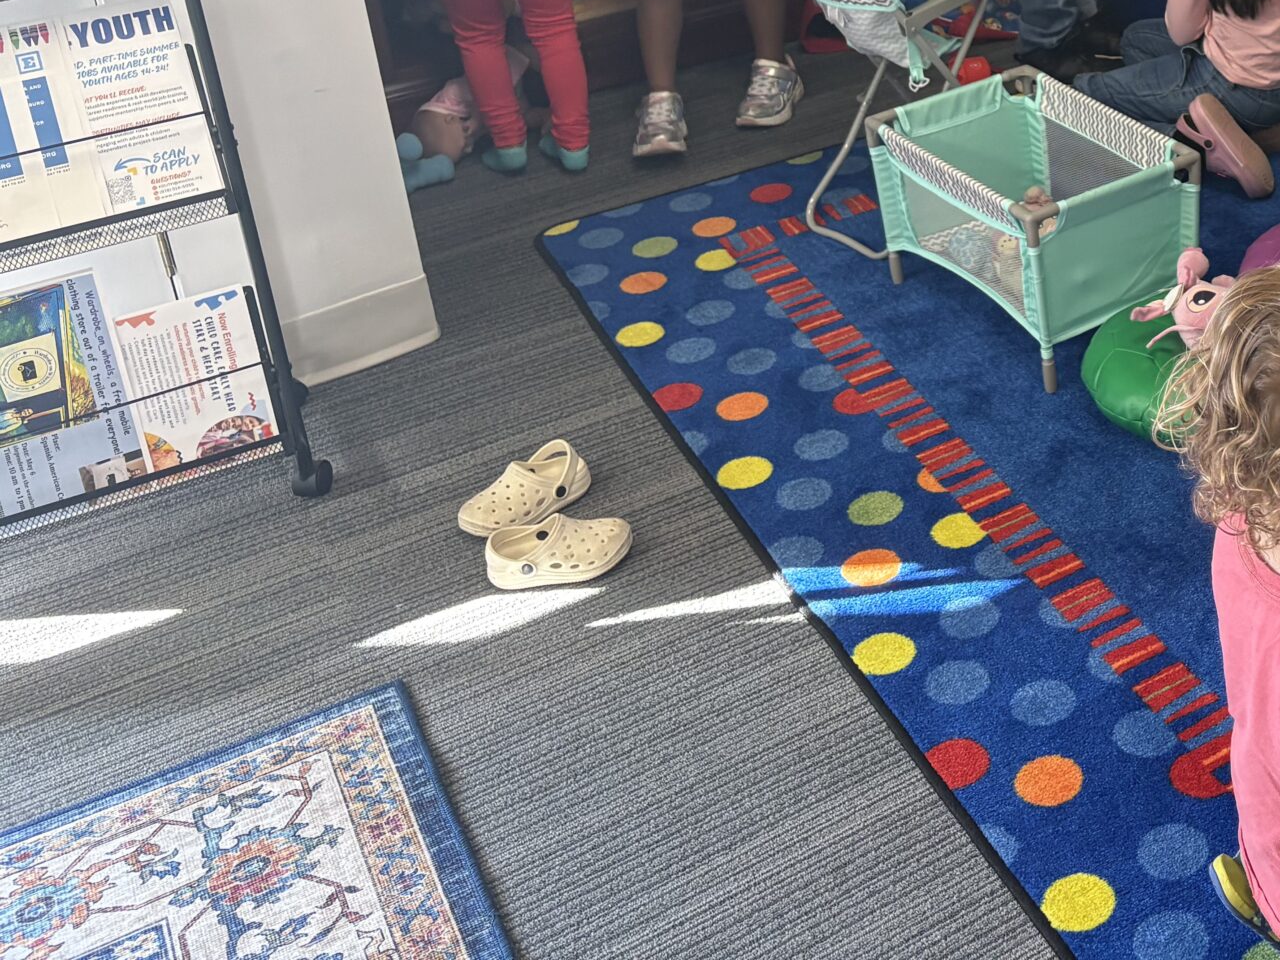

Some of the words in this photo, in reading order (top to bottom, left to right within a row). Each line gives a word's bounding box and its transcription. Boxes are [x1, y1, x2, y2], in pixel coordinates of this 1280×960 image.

[69, 6, 174, 48] YOUTH
[89, 50, 138, 67] PART-TIME
[140, 41, 180, 56] SUMMER
[77, 68, 99, 79] JOBS
[101, 58, 148, 74] AVAILABLE
[151, 53, 168, 63] FOR
[82, 76, 112, 88] YOUTH
[115, 71, 138, 82] AGES
[143, 165, 158, 176] TO
[160, 153, 200, 172] APPLY
[153, 146, 186, 163] SCAN
[150, 170, 192, 185] QUESTIONS?
[205, 316, 217, 339] CHILD
[218, 312, 228, 331] Now
[223, 332, 238, 370] Enrolling
[66, 278, 80, 310] clothing
[76, 313, 87, 334] store
[83, 337, 92, 350] out
[88, 353, 97, 362] of
[93, 373, 105, 399] trailer
[105, 417, 121, 456] everyone!
[192, 319, 206, 343] START
[202, 355, 214, 375] HEAD
[208, 375, 221, 401] TART
[218, 366, 231, 389] ERLY
[224, 392, 236, 412] HEAD
[119, 410, 130, 435] mobile
[9, 467, 17, 475] 10
[40, 436, 53, 461] Spanish
[48, 462, 61, 492] American
[11, 475, 18, 486] am
[15, 487, 21, 495] to
[17, 500, 26, 510] pm
